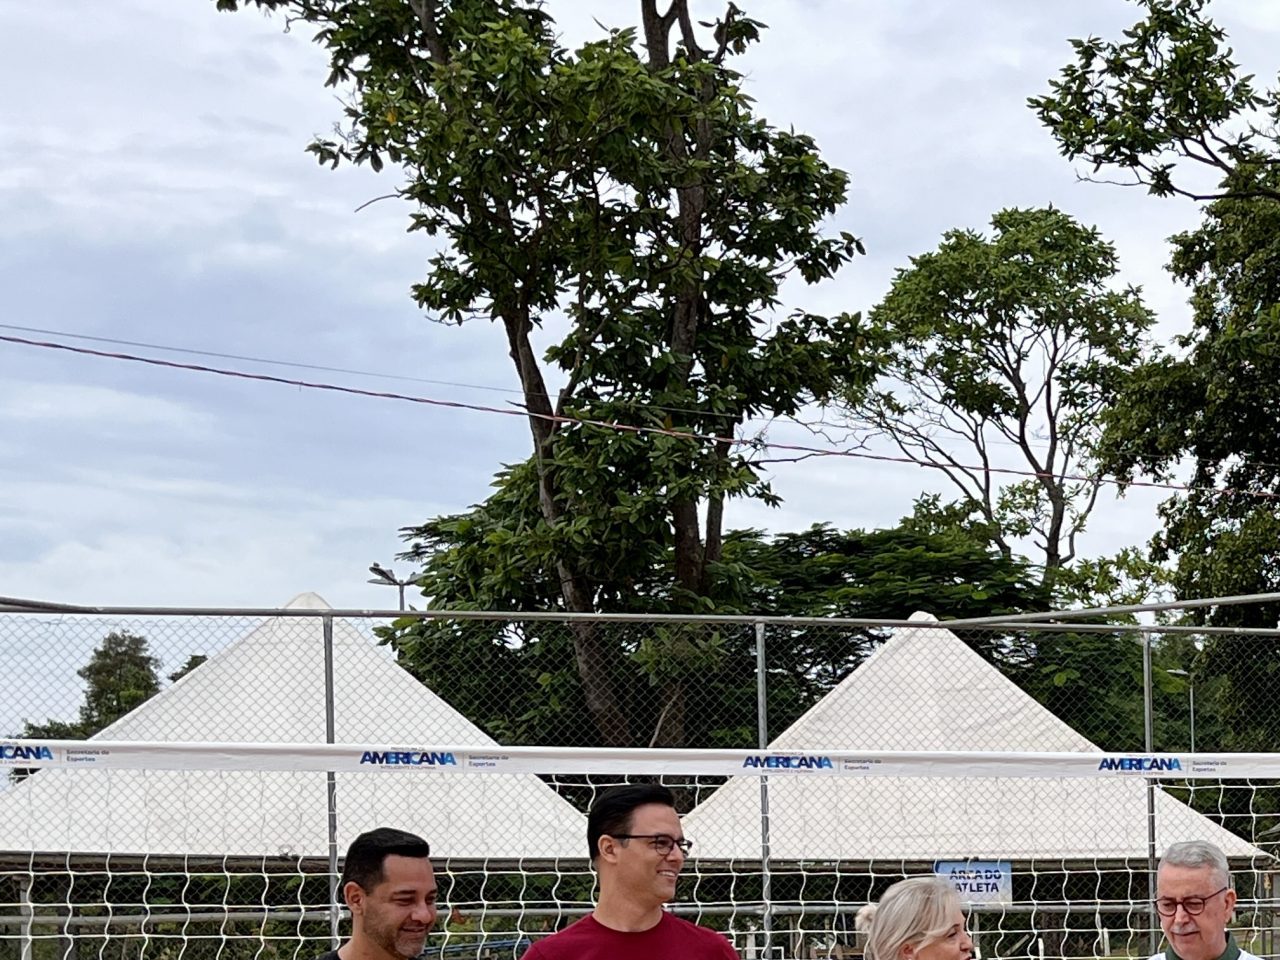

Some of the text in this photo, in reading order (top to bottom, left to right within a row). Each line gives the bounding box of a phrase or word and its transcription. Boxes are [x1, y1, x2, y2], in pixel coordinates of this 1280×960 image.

[360, 751, 457, 766] AMERICANA
[743, 756, 833, 769] AMERICANA
[1098, 758, 1182, 771] AMERICANA
